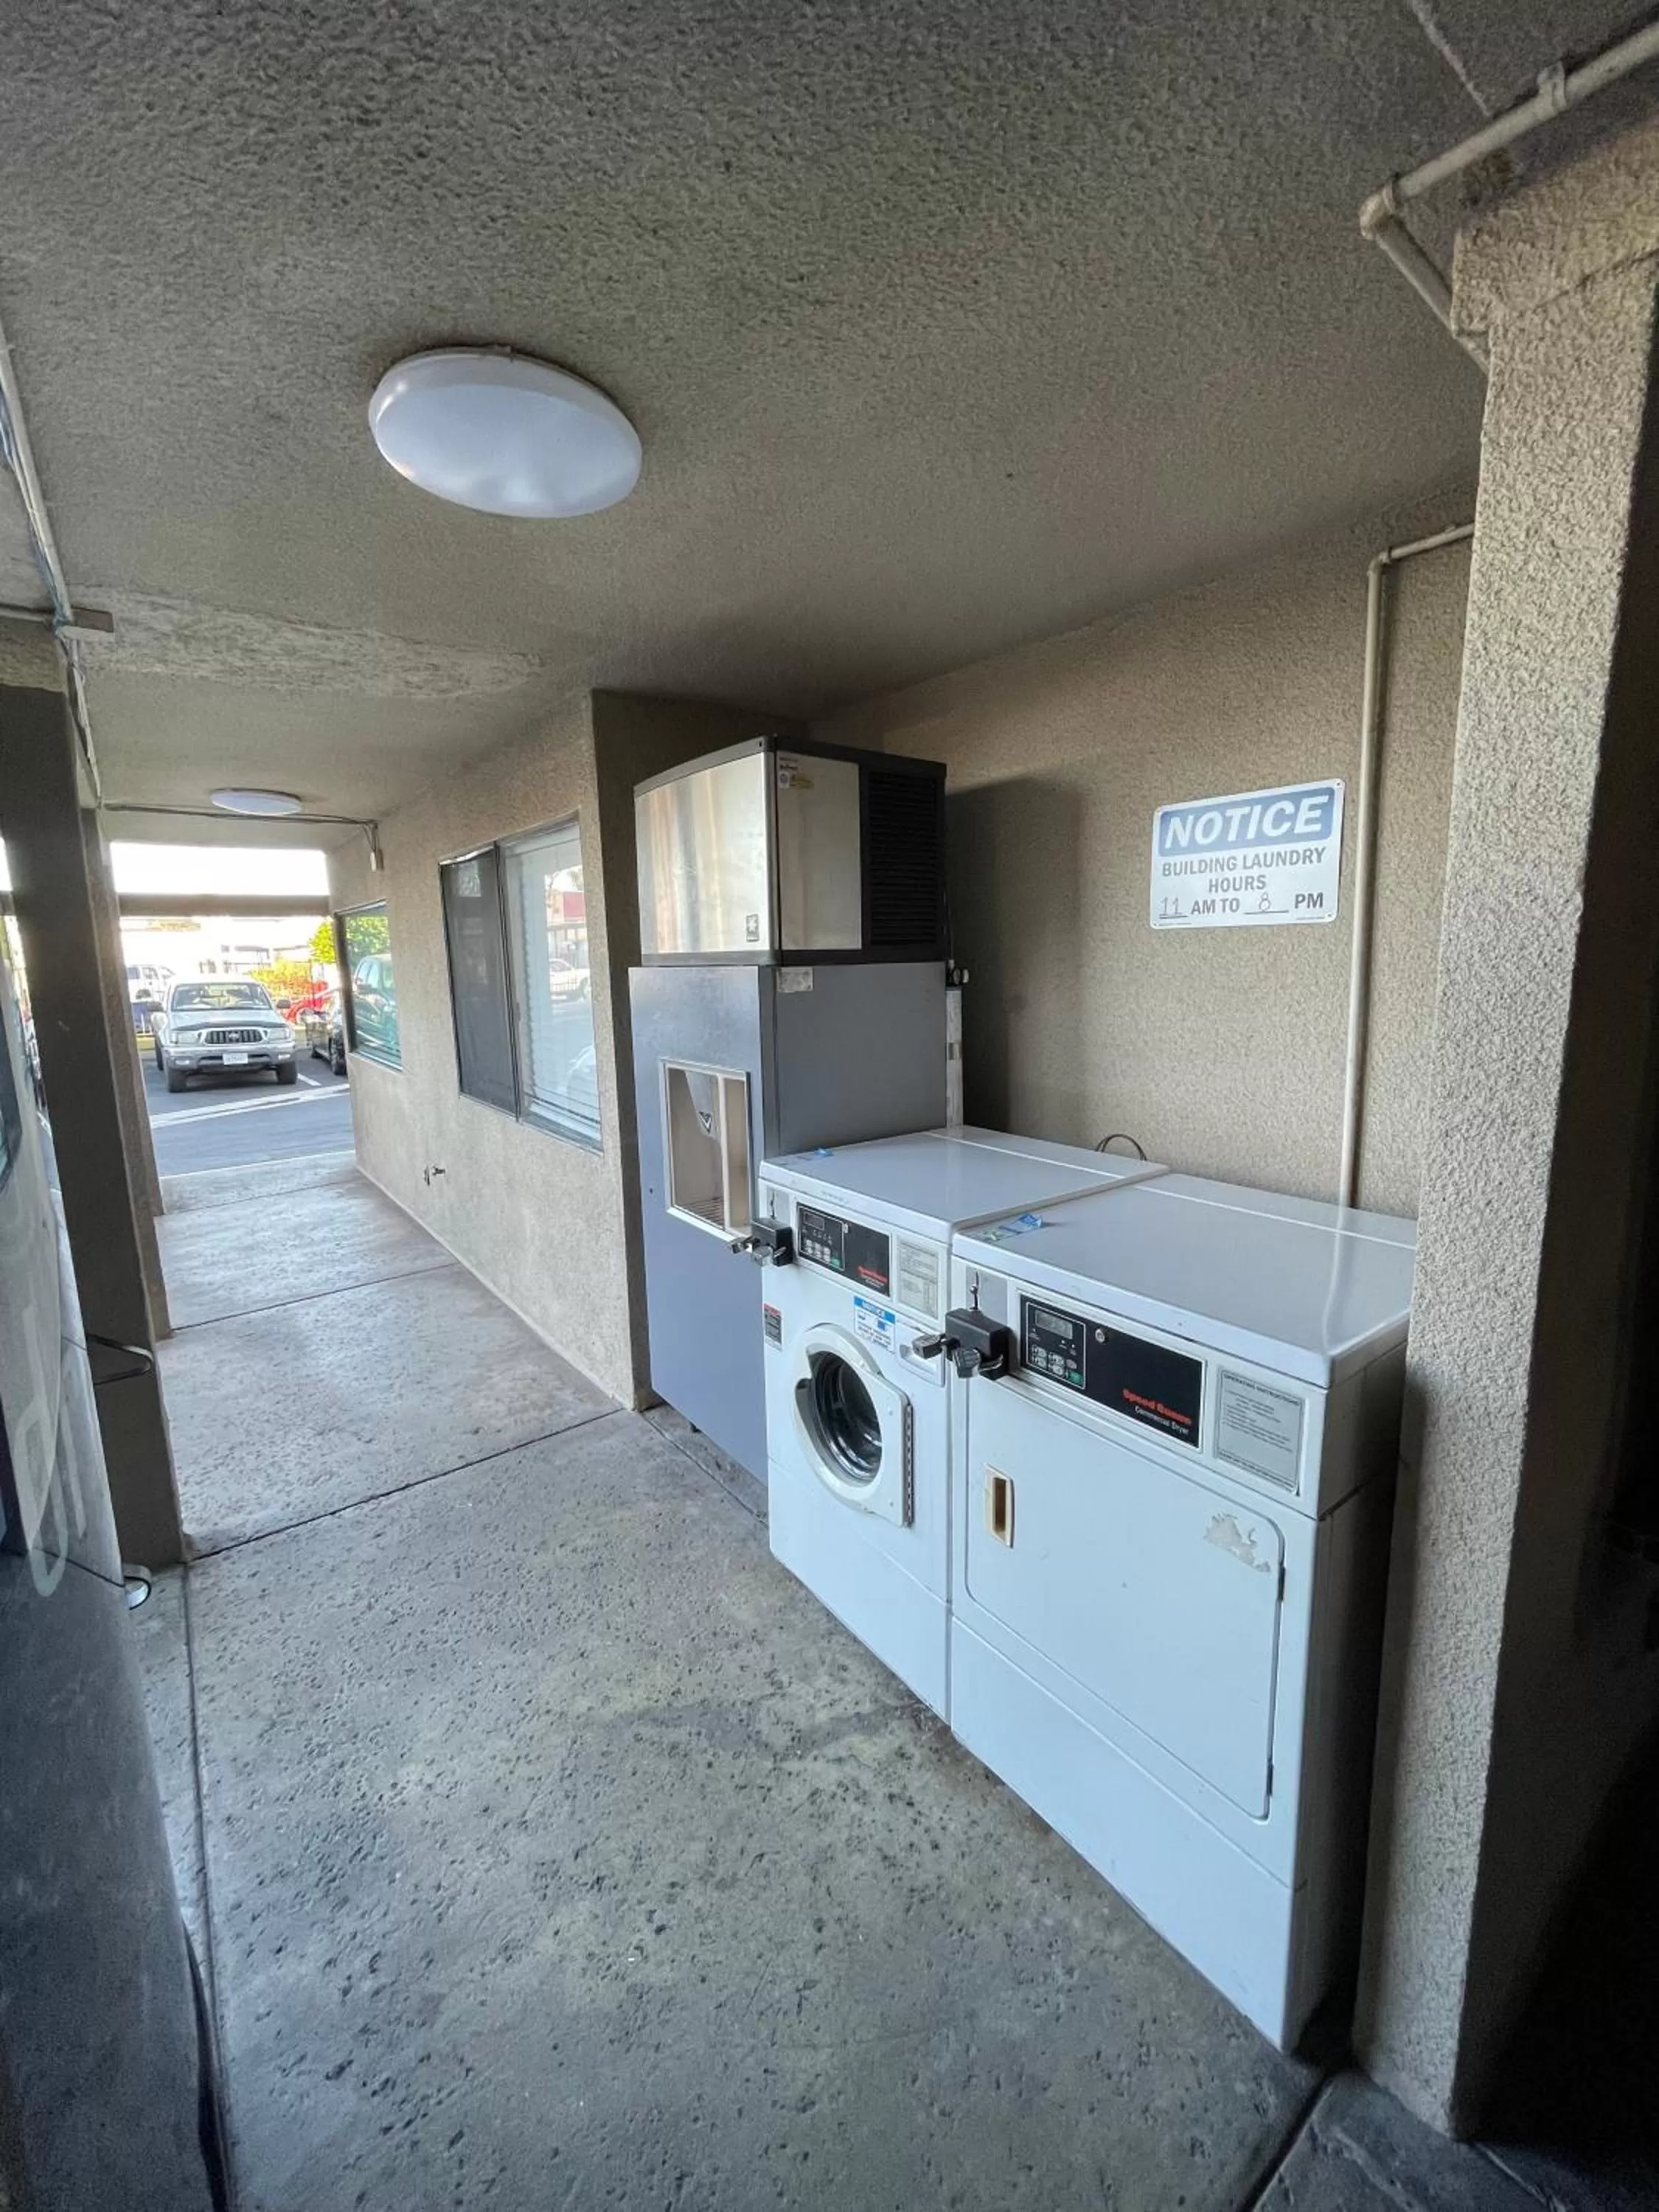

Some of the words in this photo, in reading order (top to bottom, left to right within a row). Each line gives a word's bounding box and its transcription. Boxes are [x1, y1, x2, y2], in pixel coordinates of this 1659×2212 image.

[1164, 794, 1329, 850] NOTICE
[1162, 857, 1237, 877] BUILDING
[1242, 846, 1326, 869] LAUNDRY
[1208, 874, 1267, 894] HOURS
[1191, 899, 1216, 915] AM
[1220, 897, 1240, 914] TO
[1259, 891, 1271, 913] 8
[1294, 891, 1324, 910] PM
